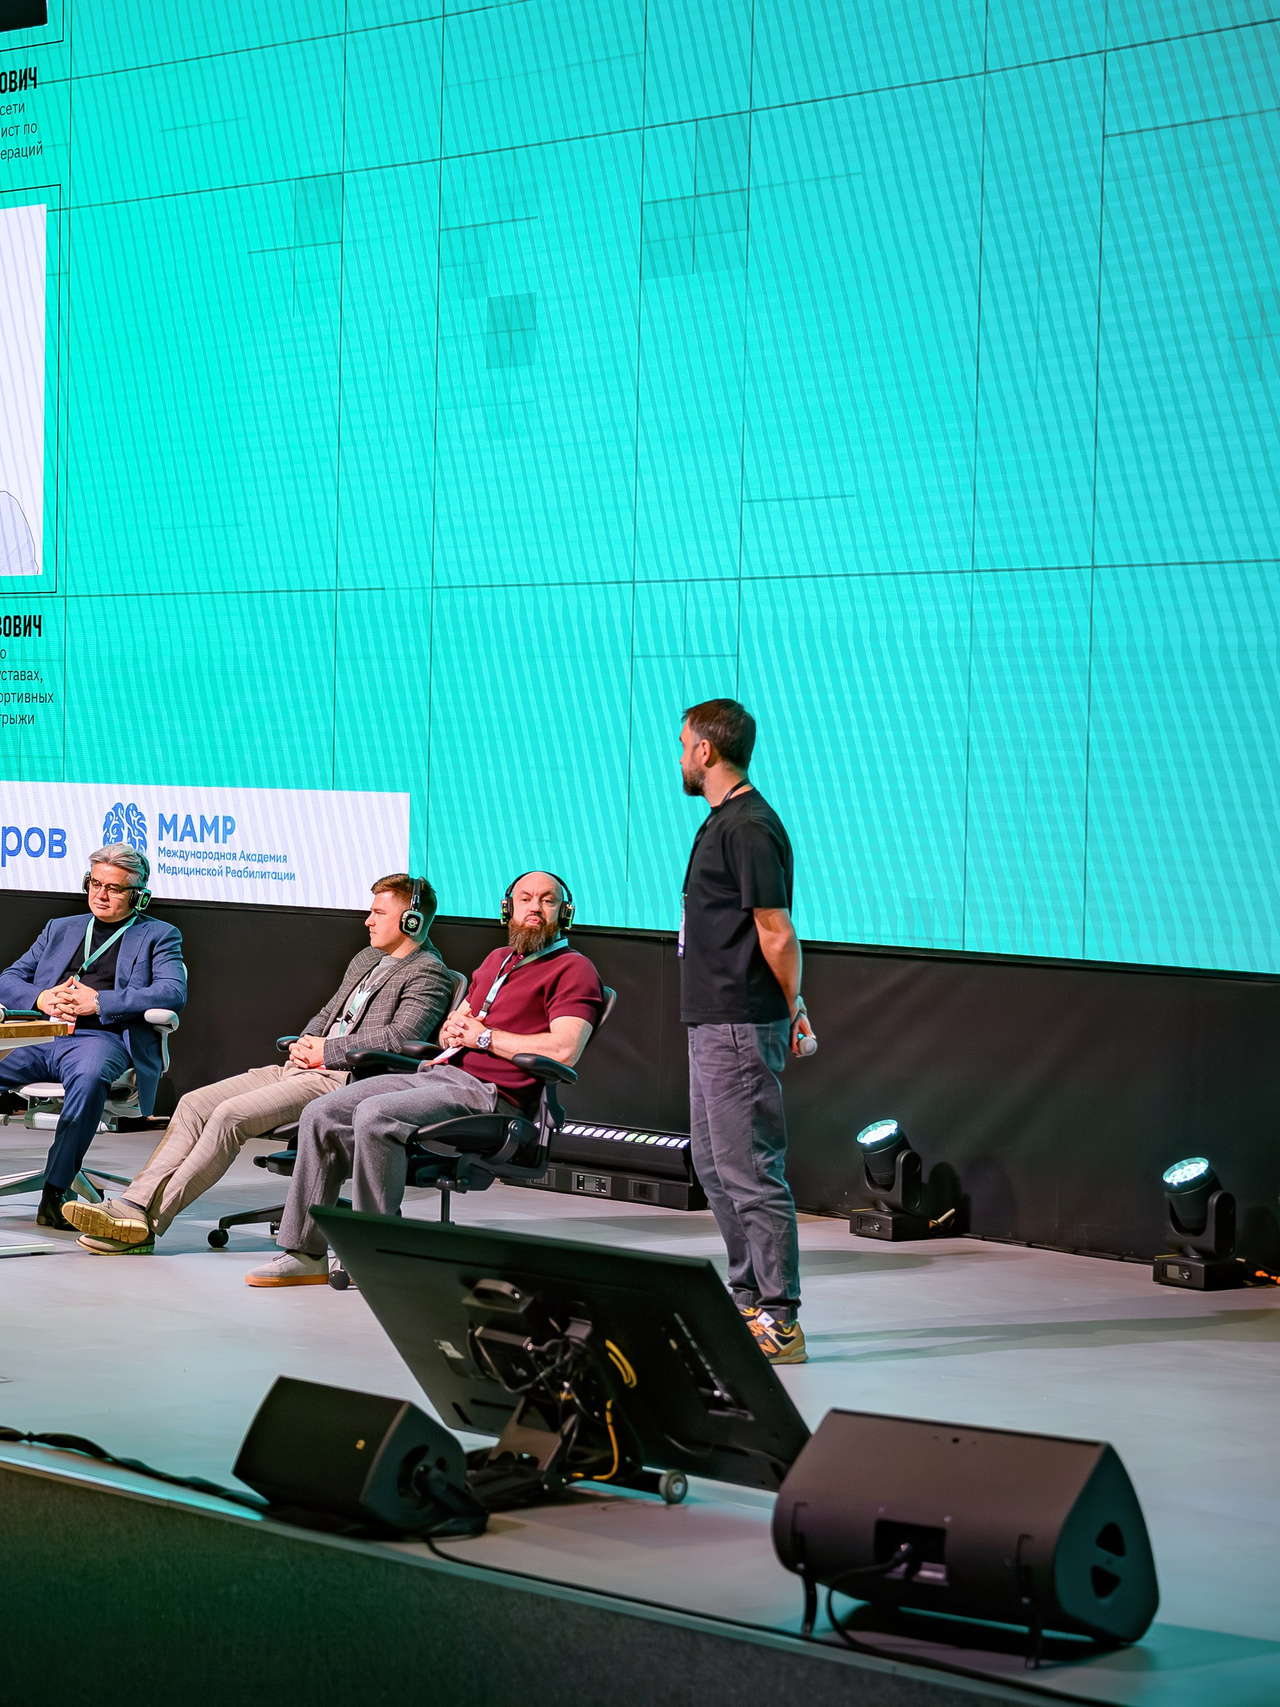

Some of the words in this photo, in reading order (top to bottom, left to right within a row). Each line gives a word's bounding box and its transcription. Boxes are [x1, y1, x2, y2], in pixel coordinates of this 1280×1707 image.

[0, 103, 25, 116] сети
[23, 123, 37, 135] по
[158, 846, 237, 862] Международная
[239, 850, 287, 863] Академия
[158, 864, 223, 878] Медицинской
[225, 866, 296, 881] Реабилитации
